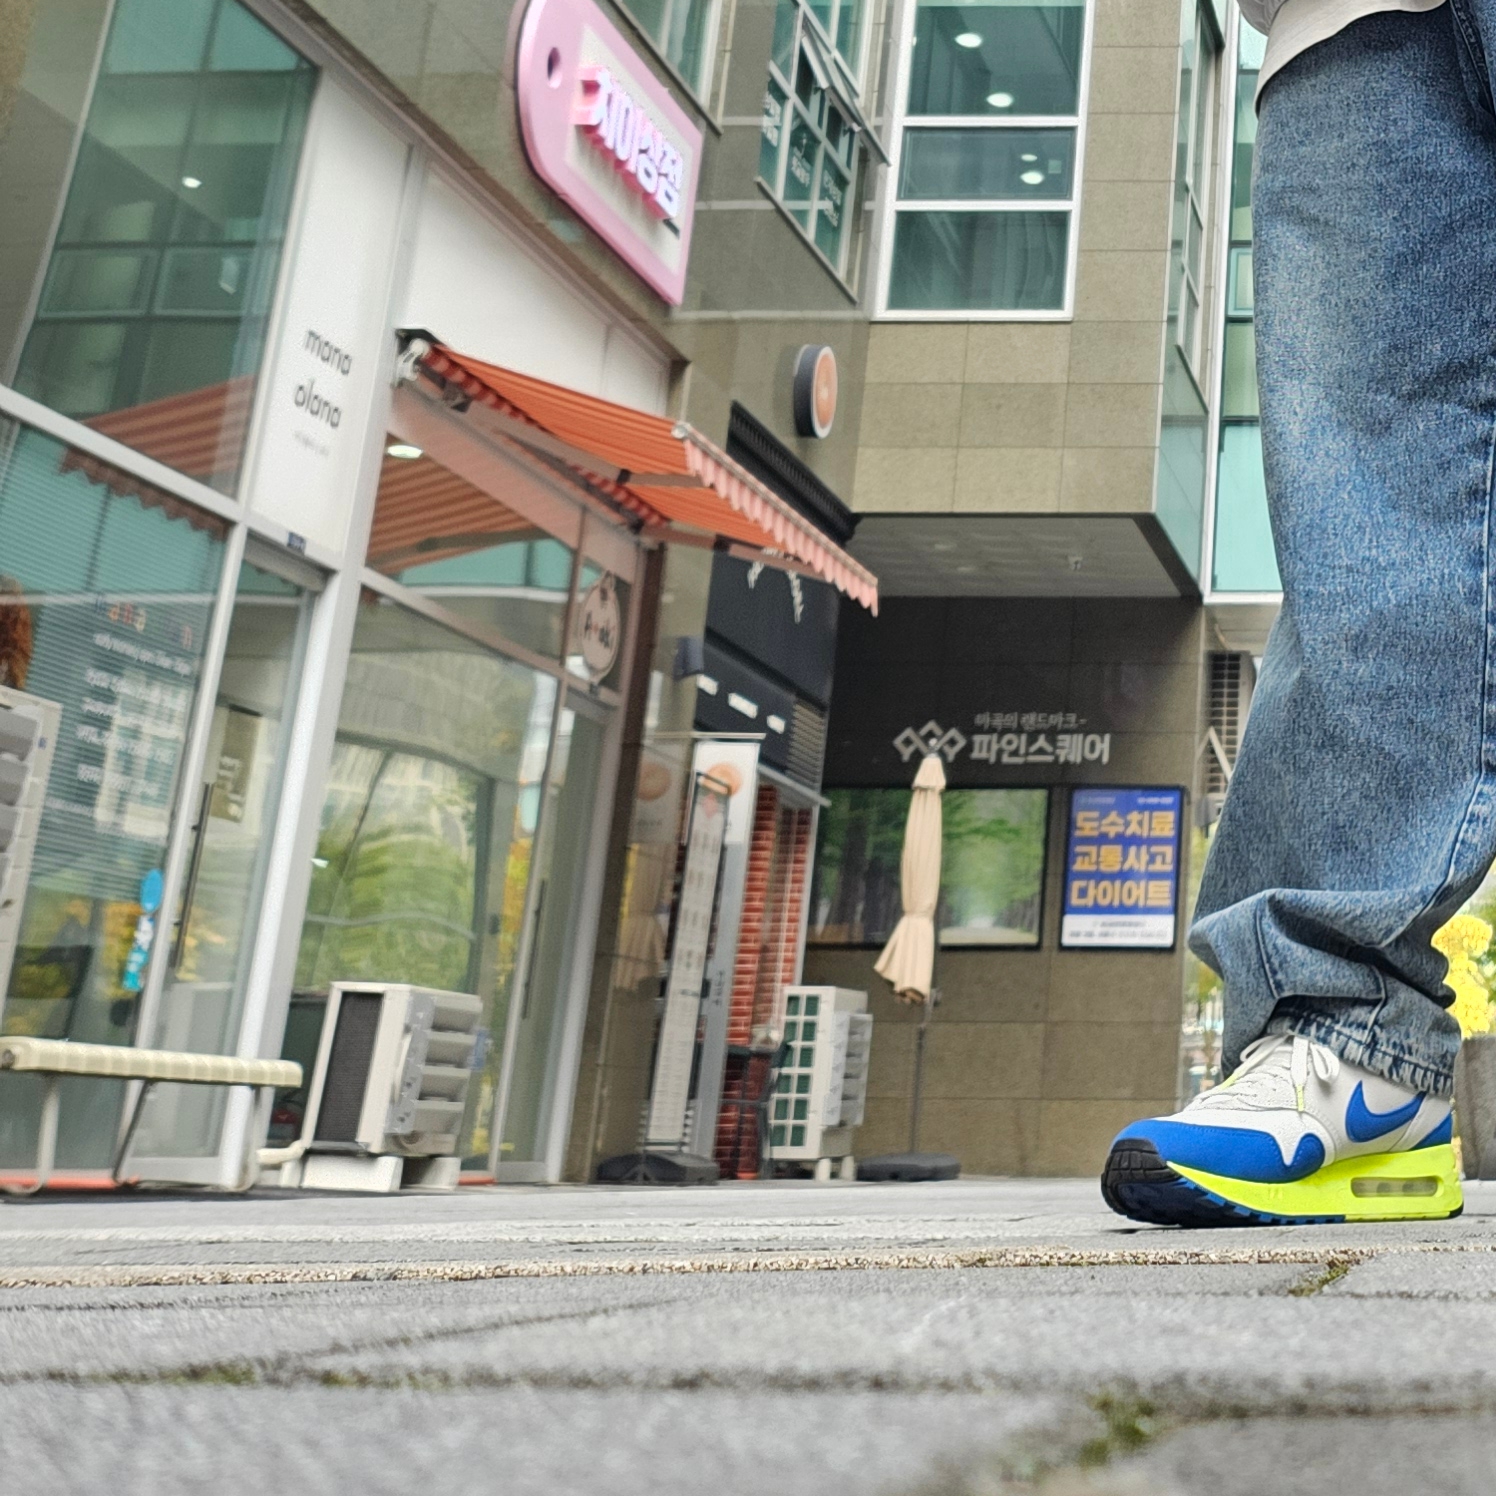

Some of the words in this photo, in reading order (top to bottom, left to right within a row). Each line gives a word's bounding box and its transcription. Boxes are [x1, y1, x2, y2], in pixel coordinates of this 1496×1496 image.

[305, 329, 353, 375] mana
[970, 732, 1111, 765] 파인스퀘어
[1074, 809, 1176, 839] 도수치료
[1072, 844, 1174, 874] 교통사고
[1069, 878, 1173, 909] 다이어트
